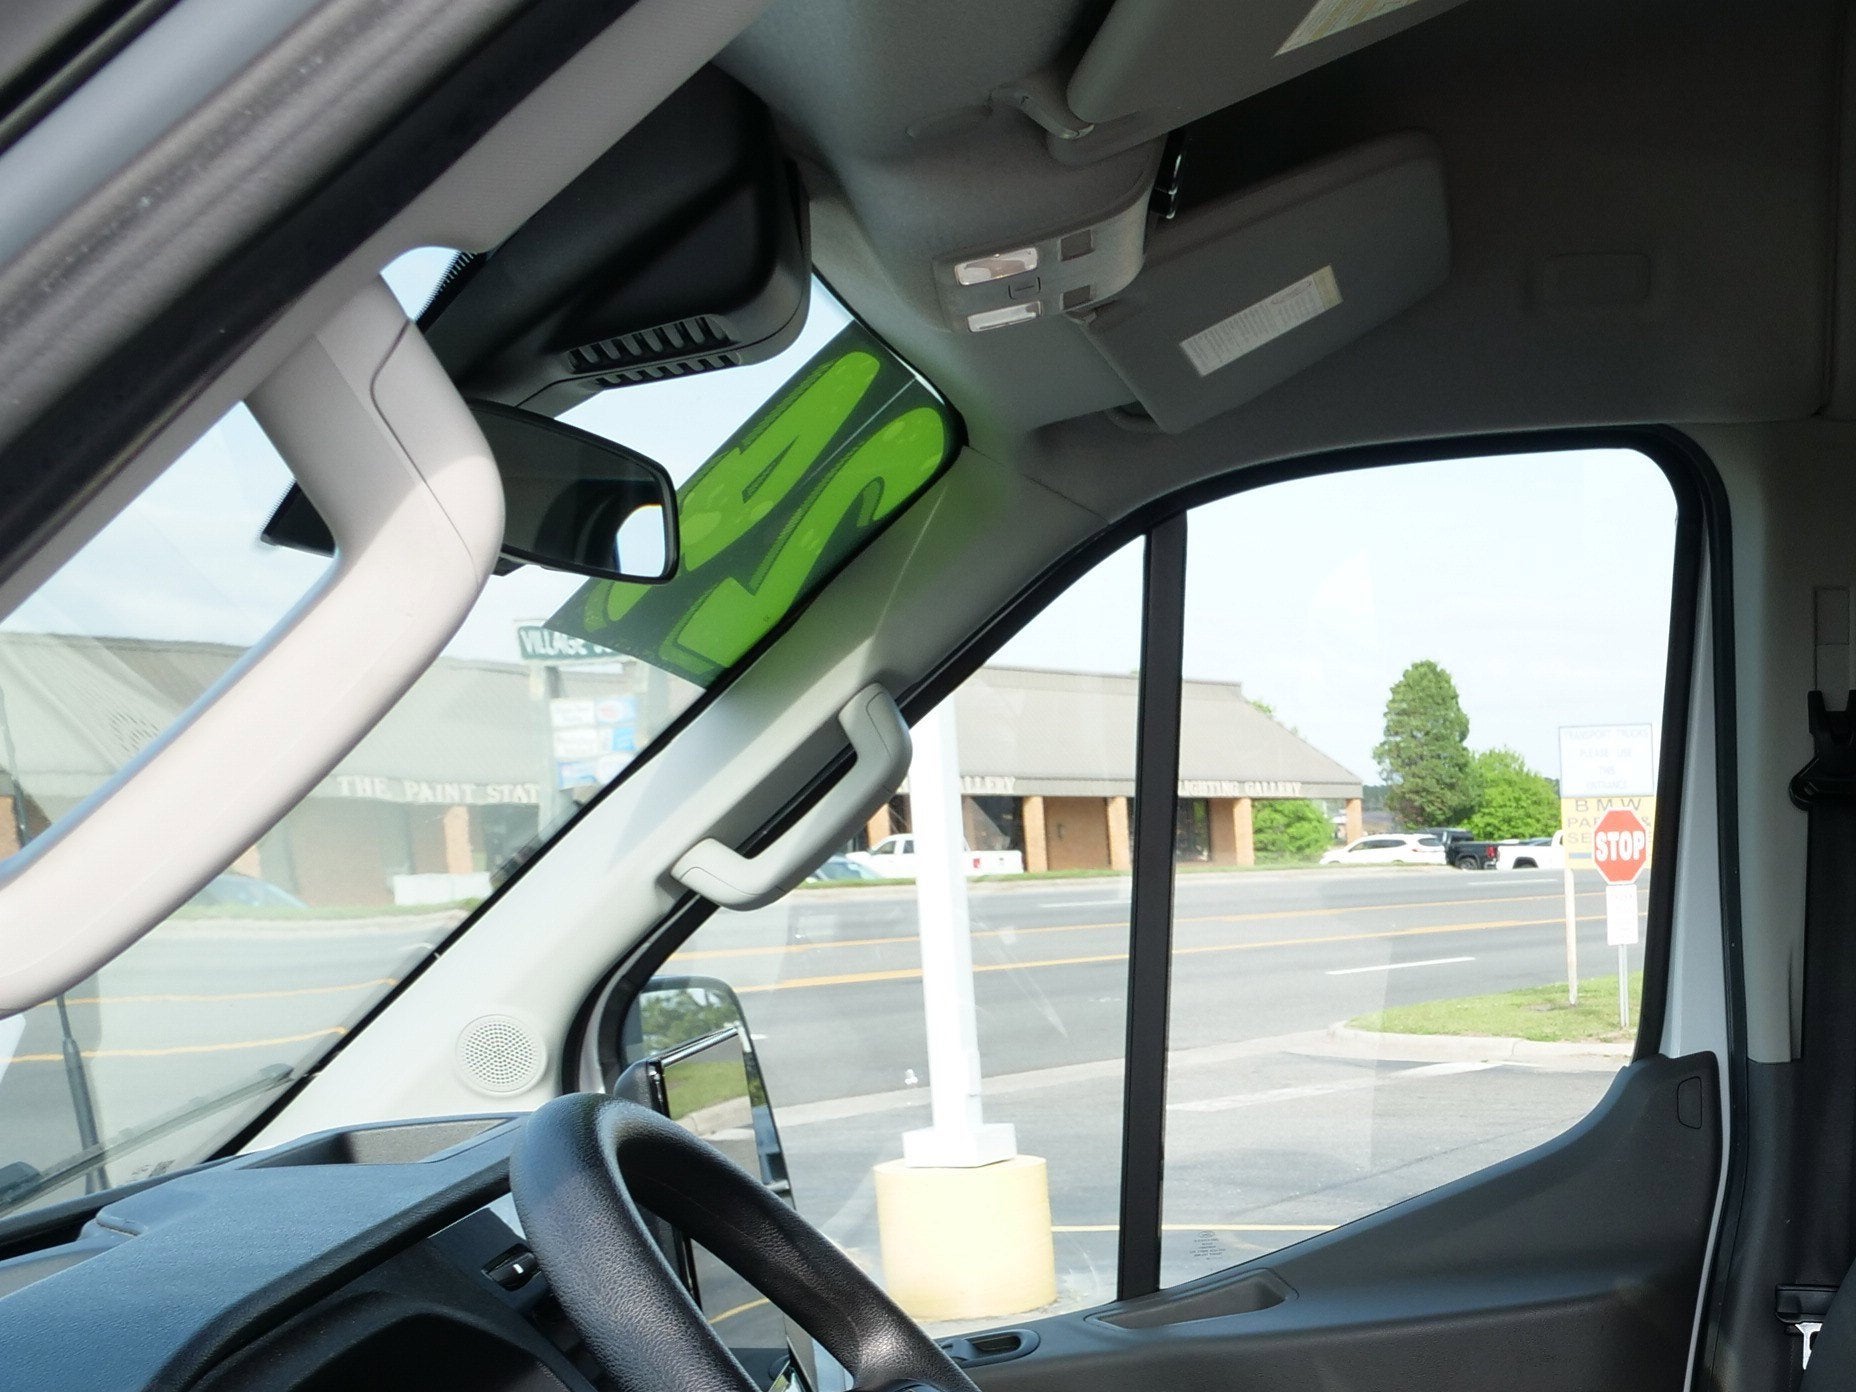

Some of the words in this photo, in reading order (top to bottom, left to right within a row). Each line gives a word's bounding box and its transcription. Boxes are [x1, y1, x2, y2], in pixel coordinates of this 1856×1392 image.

[336, 776, 391, 799] THE
[403, 780, 476, 803] PAINT
[485, 783, 539, 804] STAT
[1245, 780, 1302, 797] GALLERY
[1595, 831, 1645, 862] STOP
